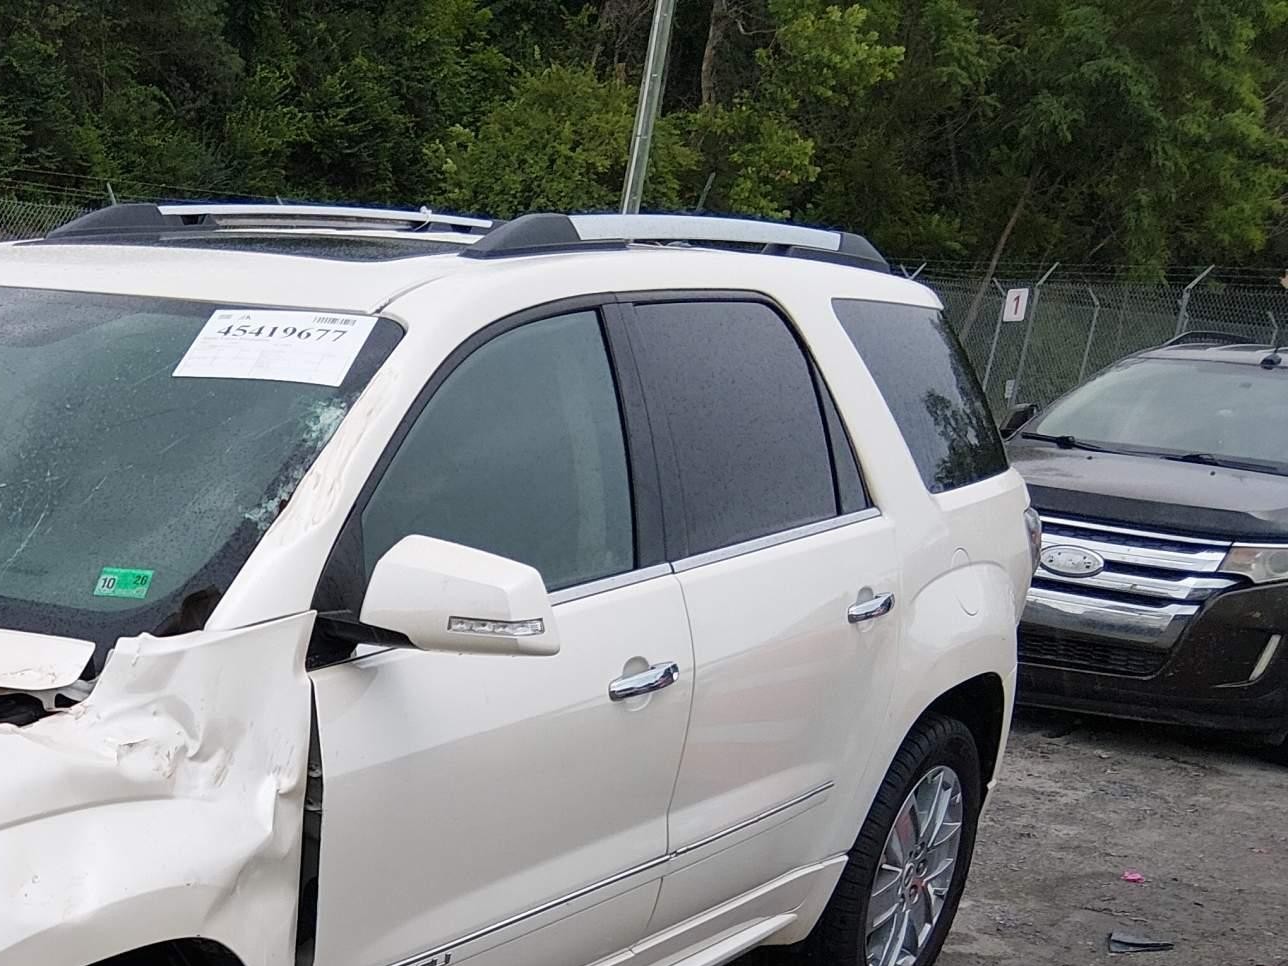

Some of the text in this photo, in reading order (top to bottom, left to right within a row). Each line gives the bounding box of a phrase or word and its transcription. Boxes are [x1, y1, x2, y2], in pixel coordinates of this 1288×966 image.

[1013, 295, 1021, 316] 1
[216, 324, 348, 343] 45419677
[101, 576, 116, 590] 10
